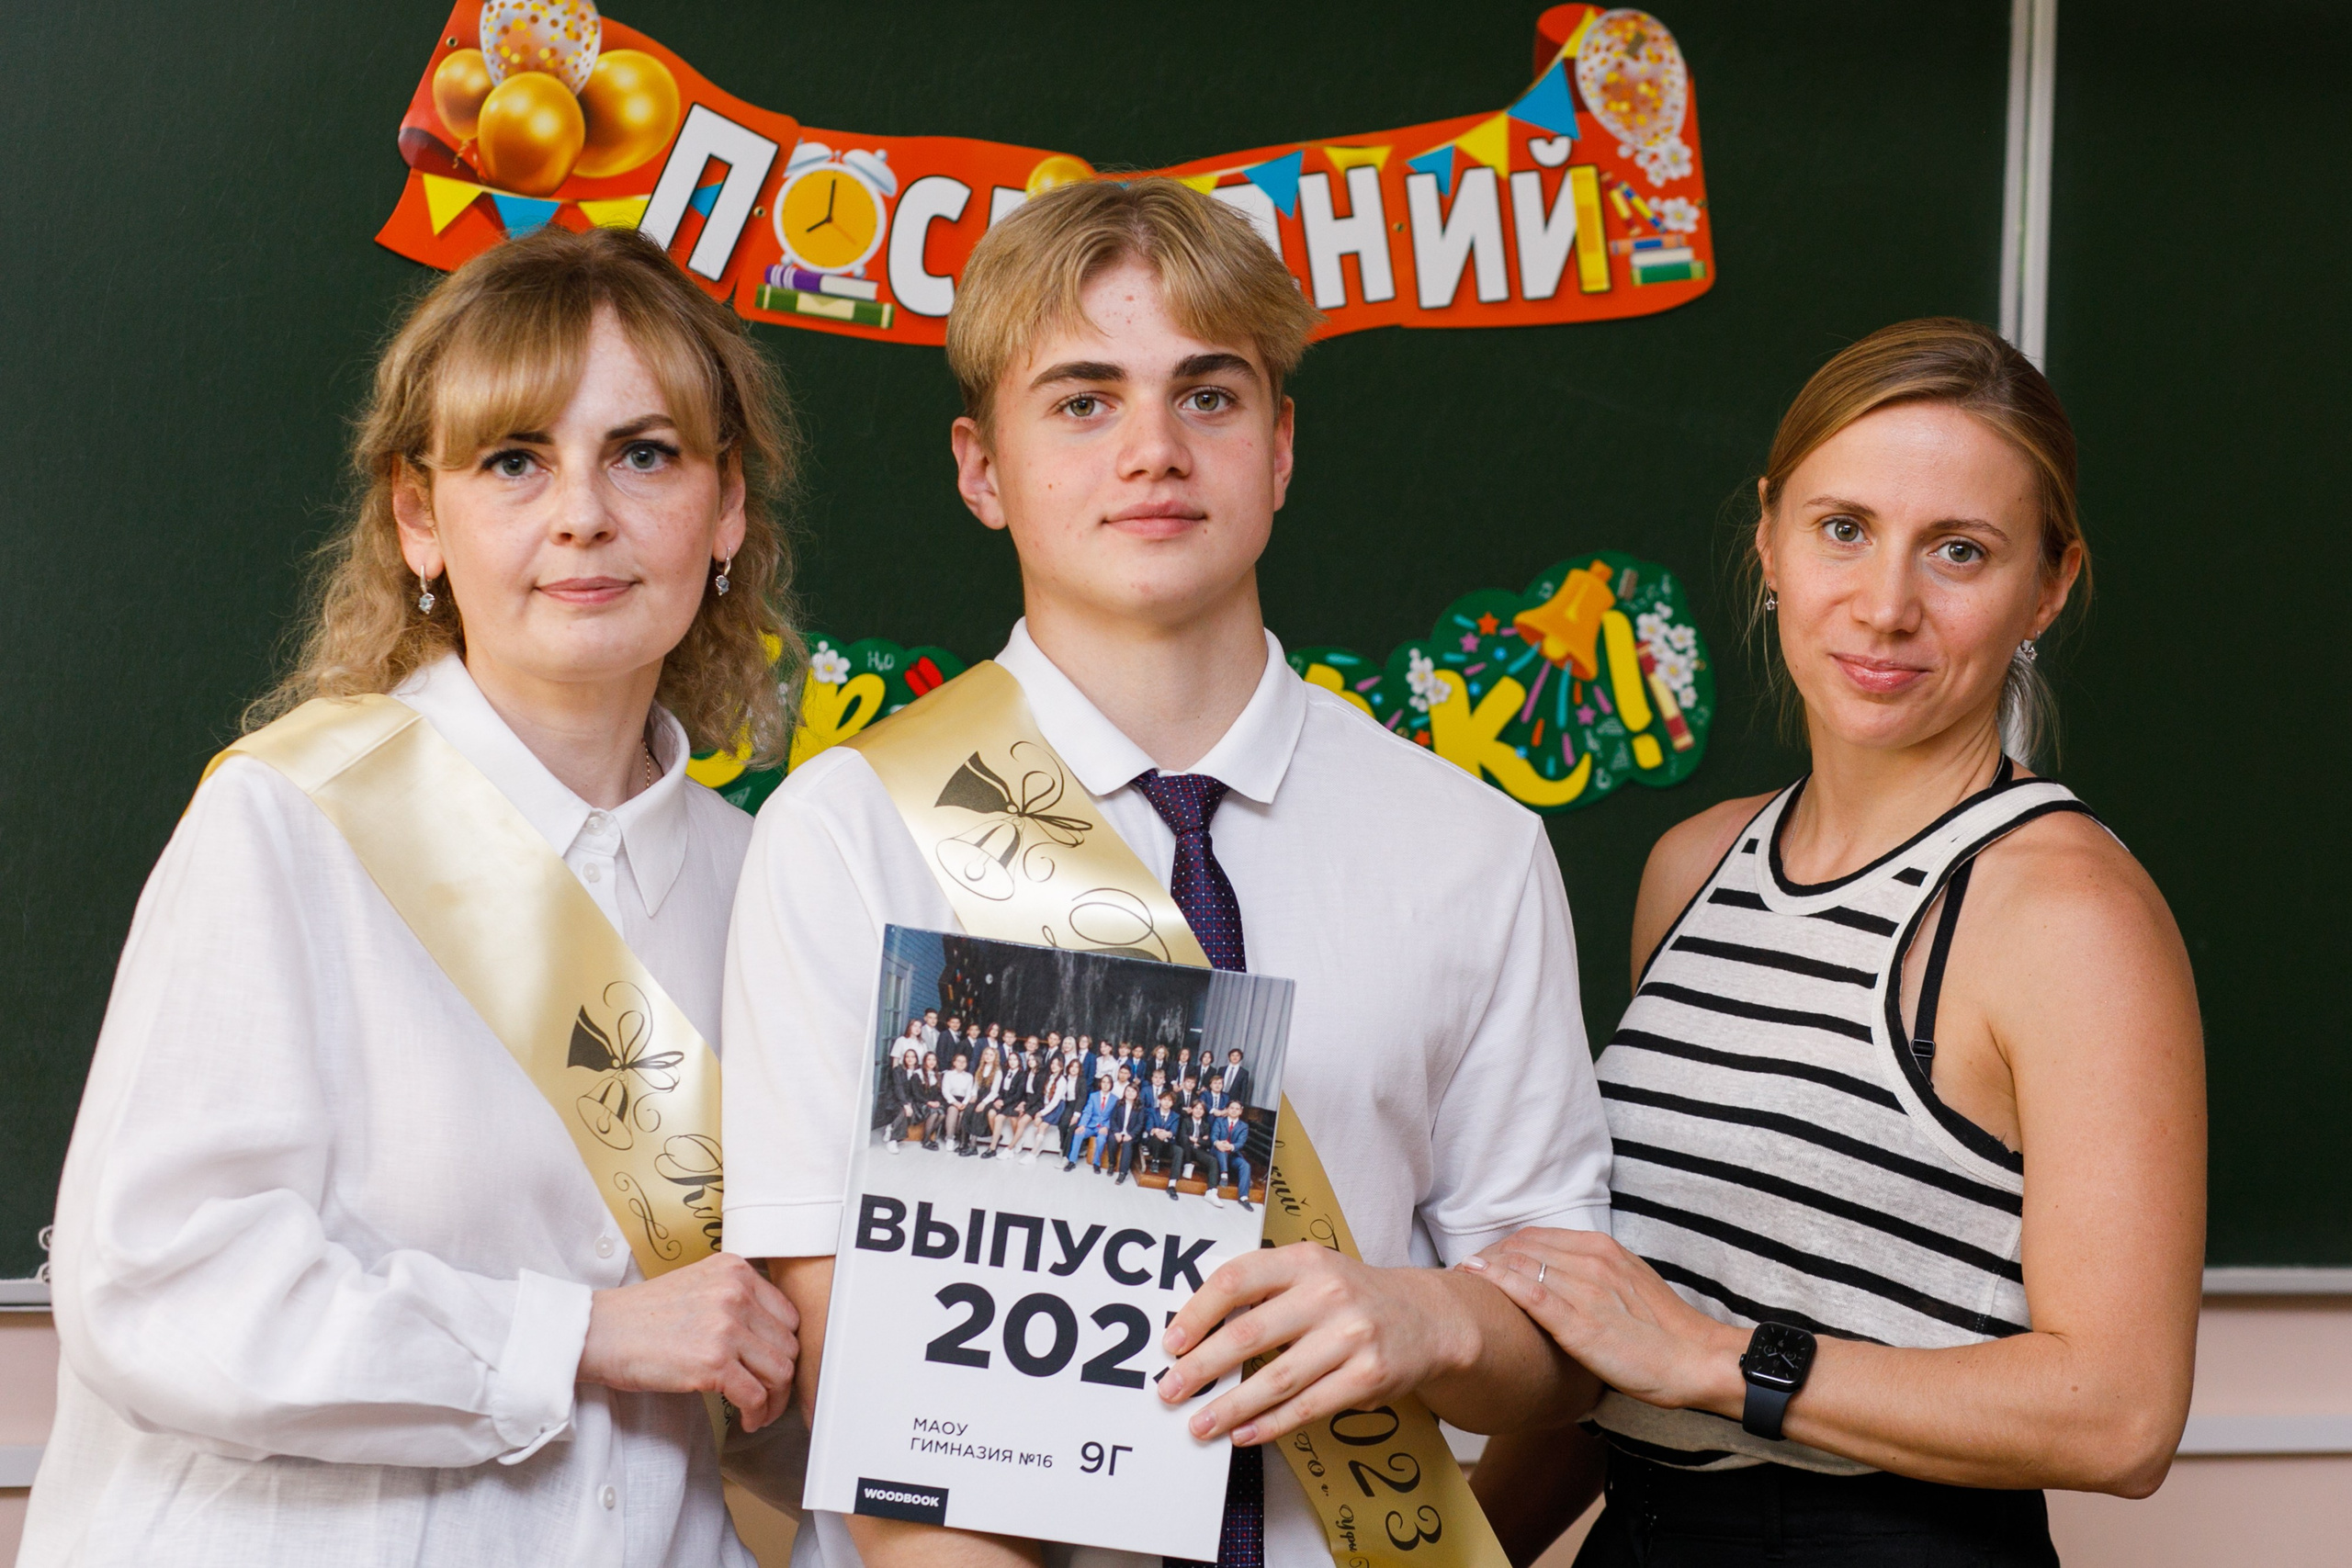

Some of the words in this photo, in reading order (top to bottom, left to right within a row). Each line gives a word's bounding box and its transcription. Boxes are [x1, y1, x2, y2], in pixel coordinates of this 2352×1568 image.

[855, 1193, 1216, 1292] ВЫПУСК
[912, 1417, 968, 1437] МАОУ
[910, 1438, 1012, 1462] ГИМНАЗИЯ
[1019, 1452, 1053, 1469] №16
[1080, 1441, 1133, 1476] 9Г
[1329, 1405, 1442, 1551] 023
[864, 1488, 939, 1507] WOODBOOK
